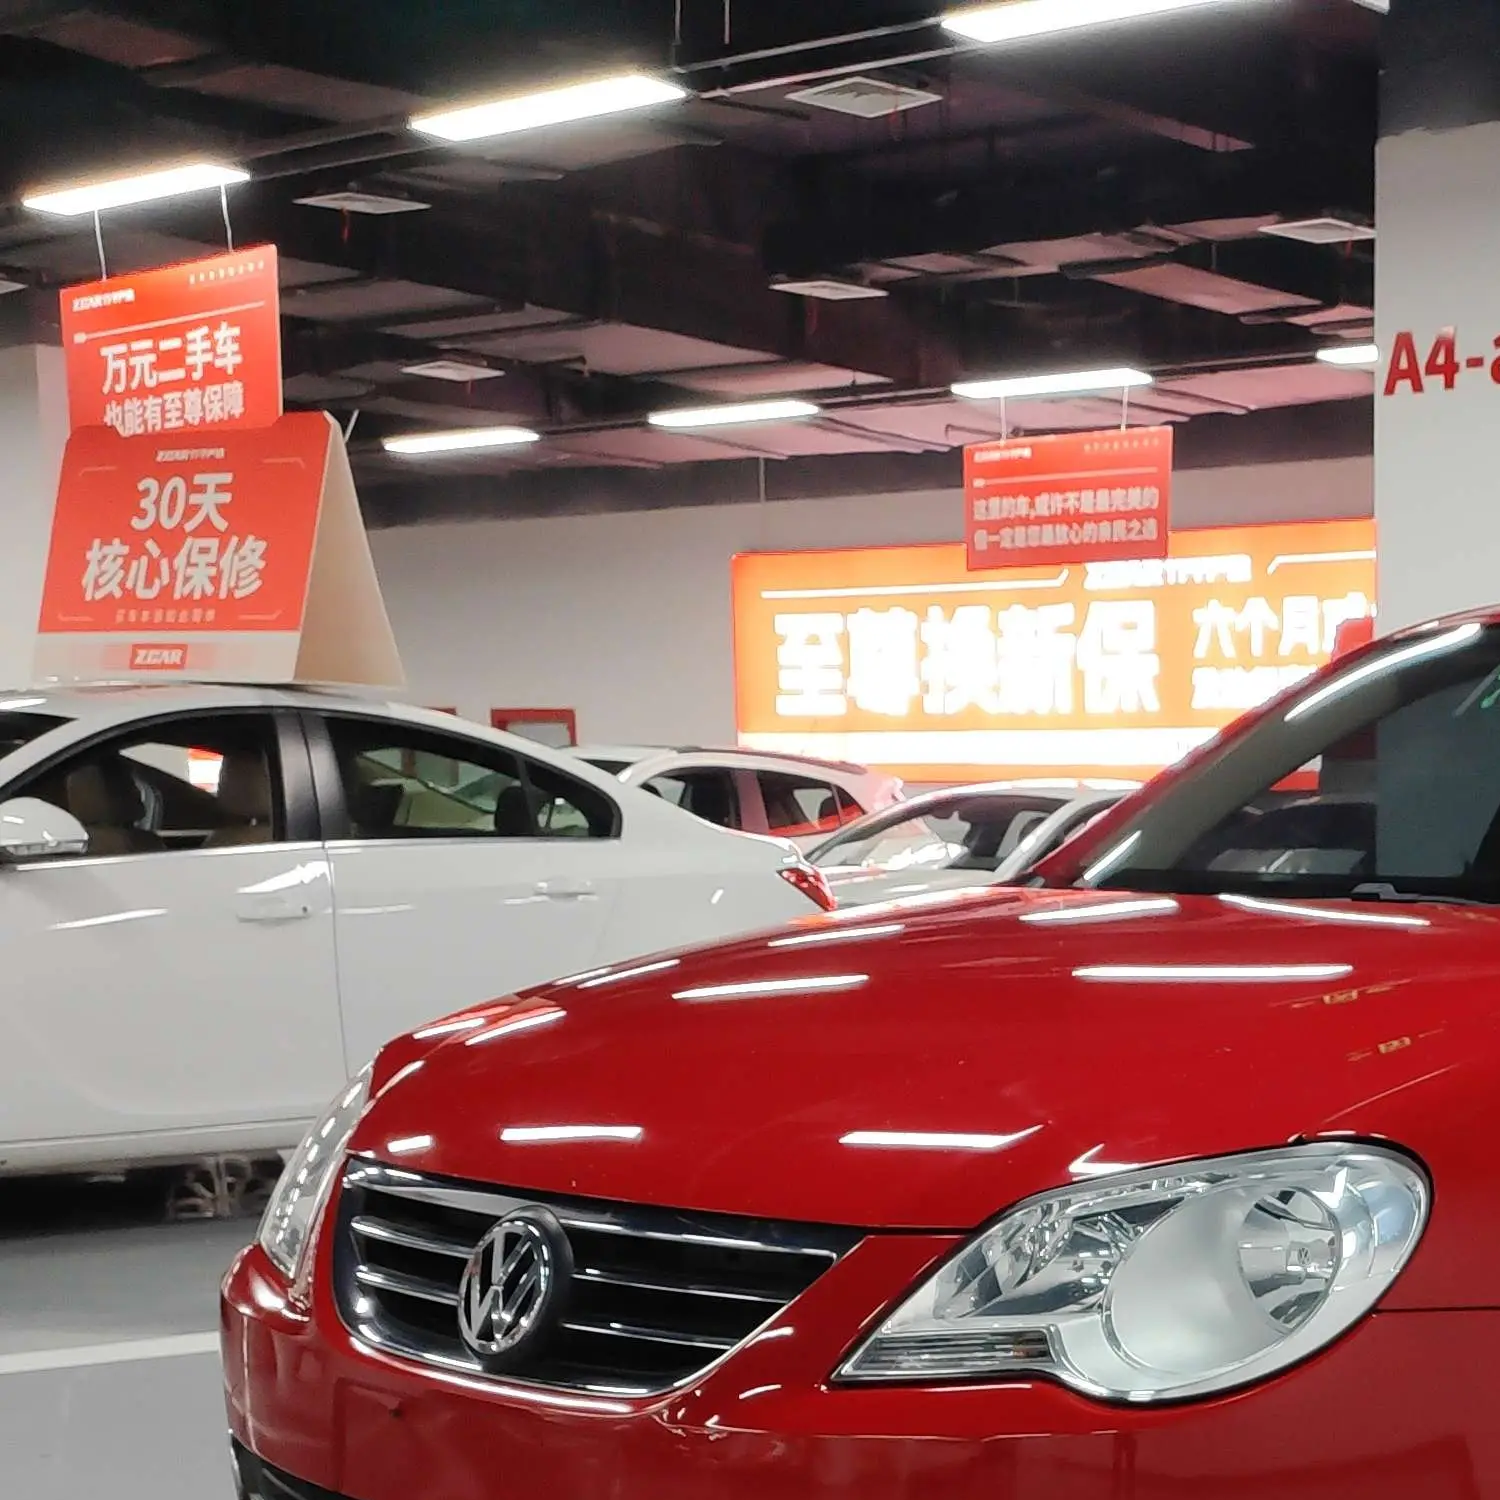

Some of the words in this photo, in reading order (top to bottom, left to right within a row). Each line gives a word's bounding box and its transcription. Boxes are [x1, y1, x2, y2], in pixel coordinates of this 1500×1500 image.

[100, 321, 243, 395] 万元二手车
[104, 380, 244, 437] 也能有至尊保障
[130, 472, 234, 533] 30天
[81, 535, 268, 602] 核心保修
[774, 600, 1160, 717] 至尊换新保
